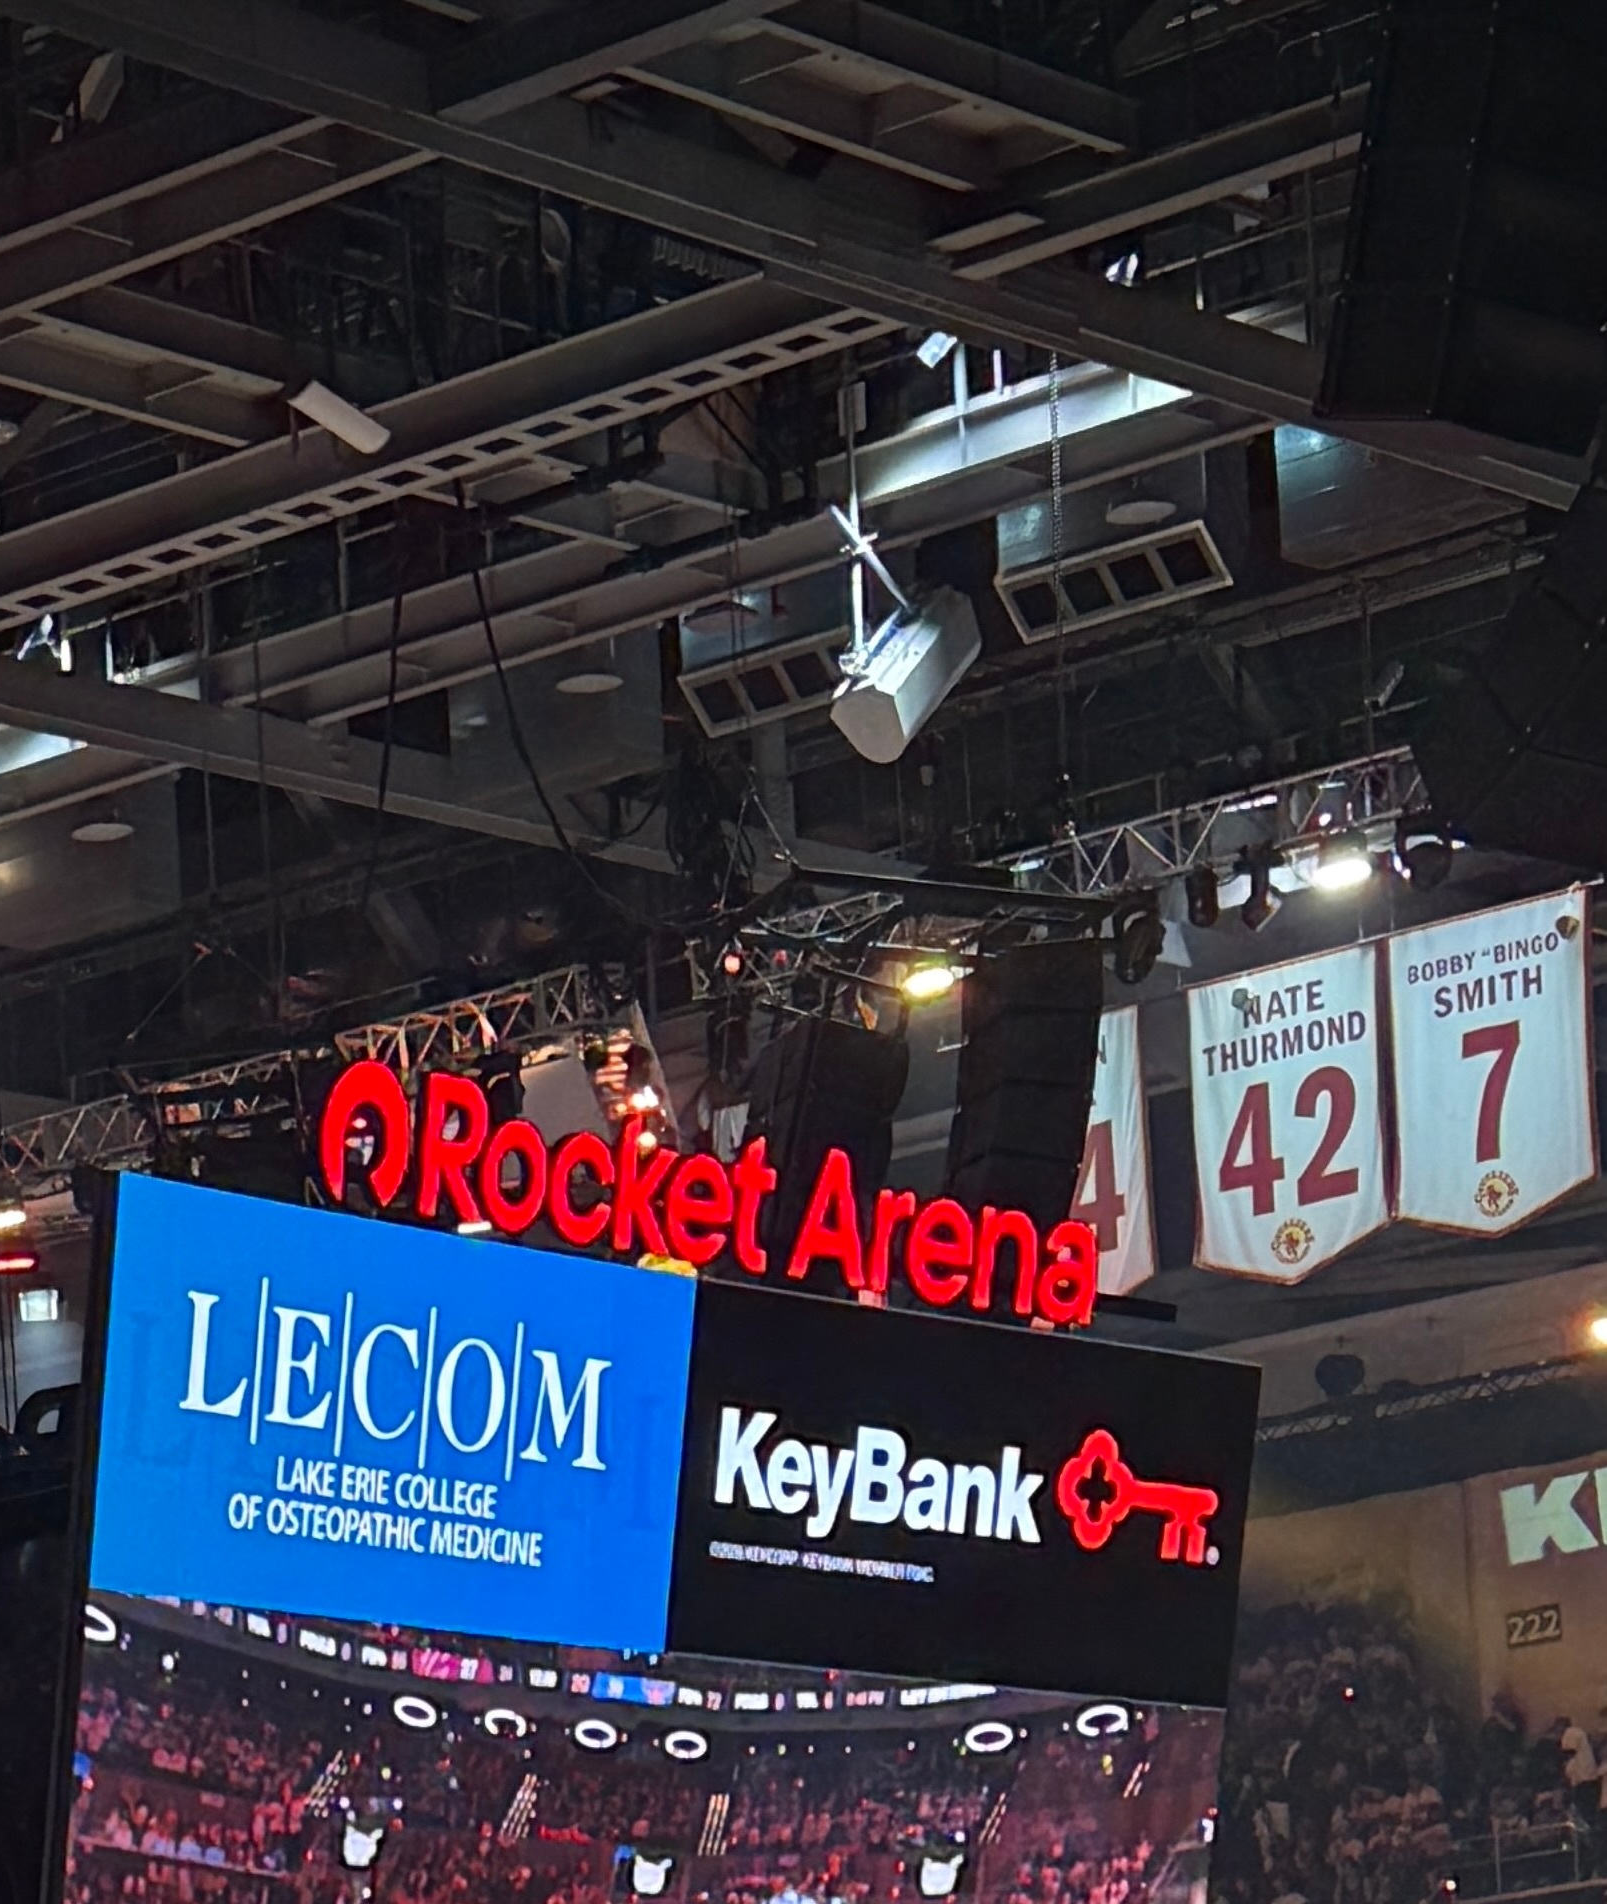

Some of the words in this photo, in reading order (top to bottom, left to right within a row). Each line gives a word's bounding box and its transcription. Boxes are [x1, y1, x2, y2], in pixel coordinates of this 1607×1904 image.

[1407, 950, 1477, 985] BOBBY
[1433, 963, 1545, 1019] SMITH
[1241, 978, 1325, 1028] NATE
[1201, 1009, 1367, 1077] THURMOND
[1460, 1020, 1521, 1164] 7
[1218, 1065, 1360, 1217] 42
[417, 1071, 777, 1277] Rocket
[787, 1149, 1102, 1329] Arena
[276, 1455, 337, 1498] LAKE
[341, 1464, 391, 1505] ERIE
[394, 1472, 498, 1520] COLLEGE
[714, 1406, 1044, 1543] KeyBank
[228, 1493, 262, 1530] OF
[266, 1498, 426, 1554] OSTEOPATHIC
[430, 1520, 544, 1568] MEDICINE
[1507, 1609, 1562, 1645] 222
